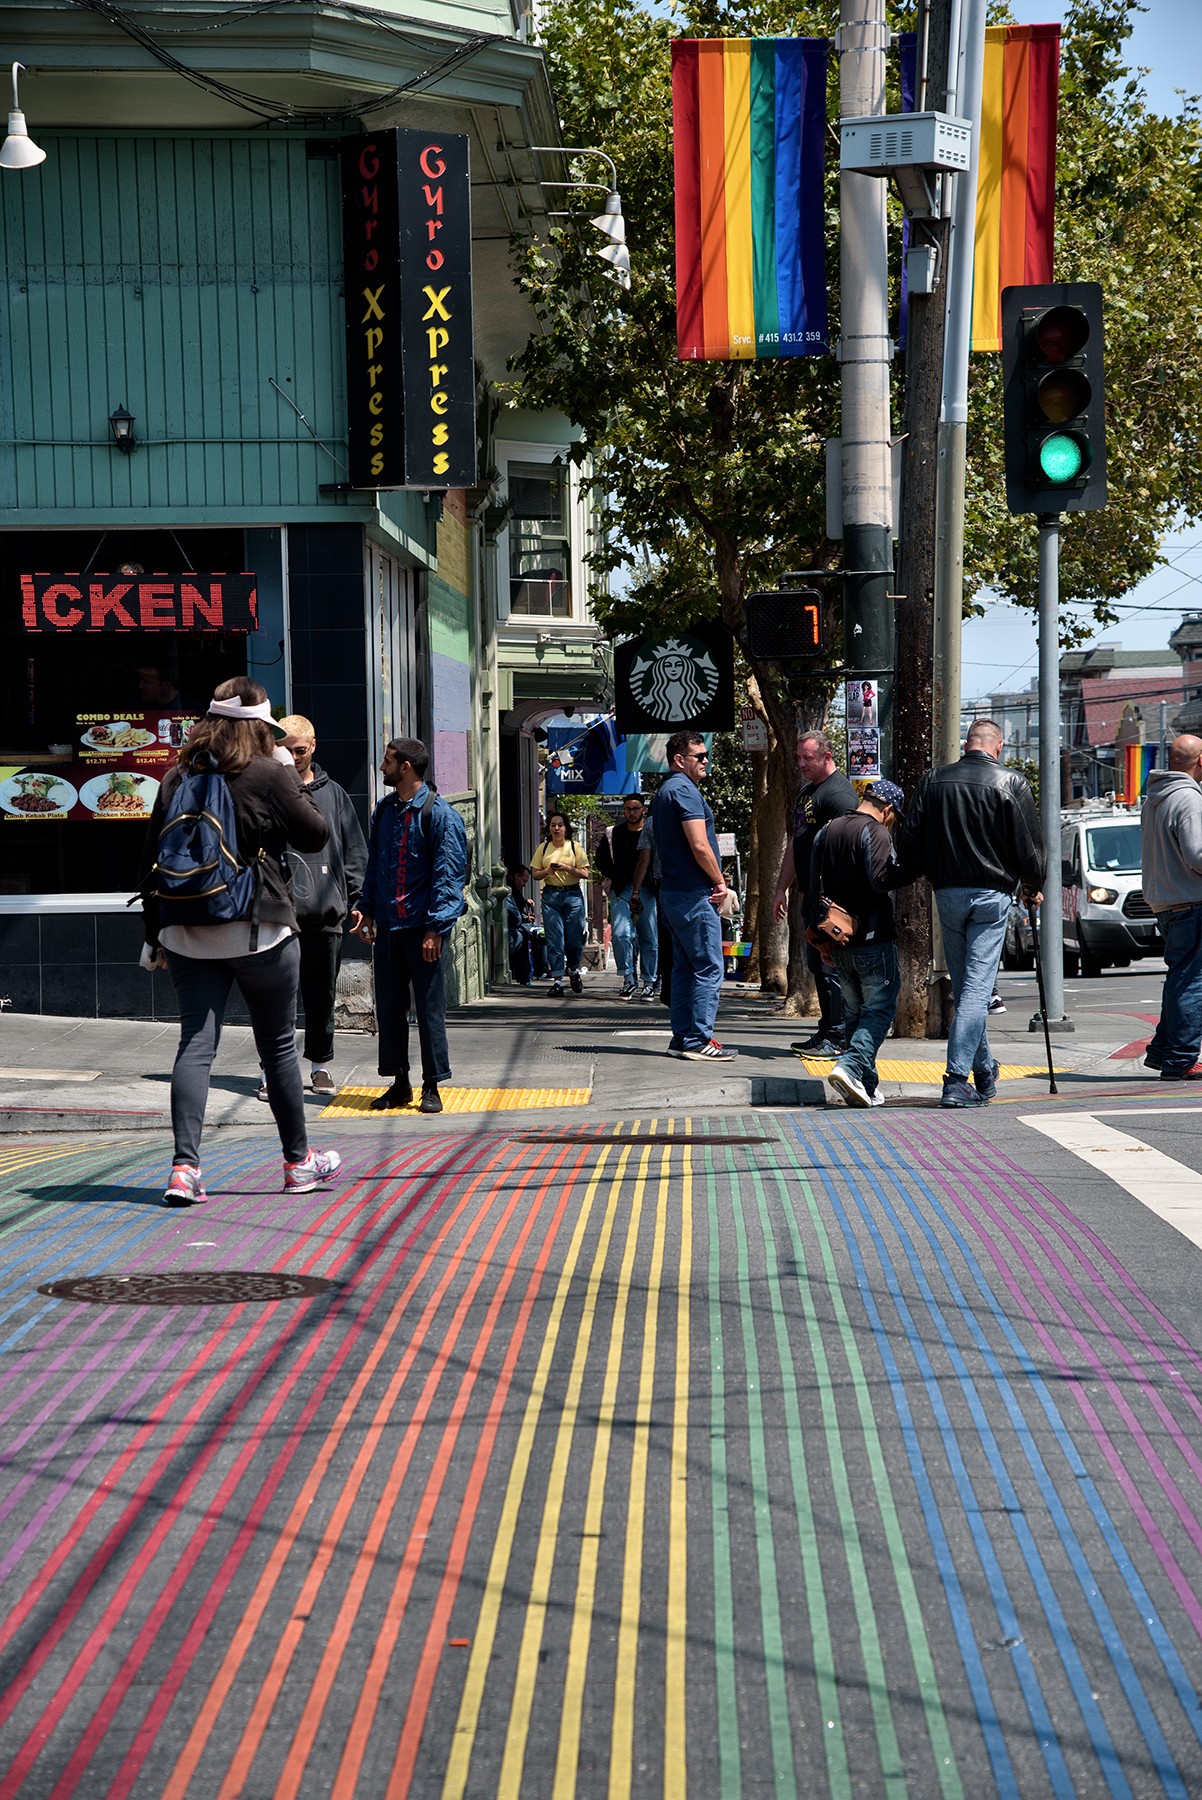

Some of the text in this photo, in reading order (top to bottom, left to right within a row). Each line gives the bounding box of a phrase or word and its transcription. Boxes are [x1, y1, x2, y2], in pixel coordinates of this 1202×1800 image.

[358, 144, 386, 476] Gyro Xpress
[419, 144, 452, 475] Gyro Xpress
[733, 334, 754, 344] Srvc.
[782, 332, 803, 342] 431.2
[806, 331, 821, 341] 359
[742, 708, 754, 719] NO
[561, 770, 584, 779] MIX
